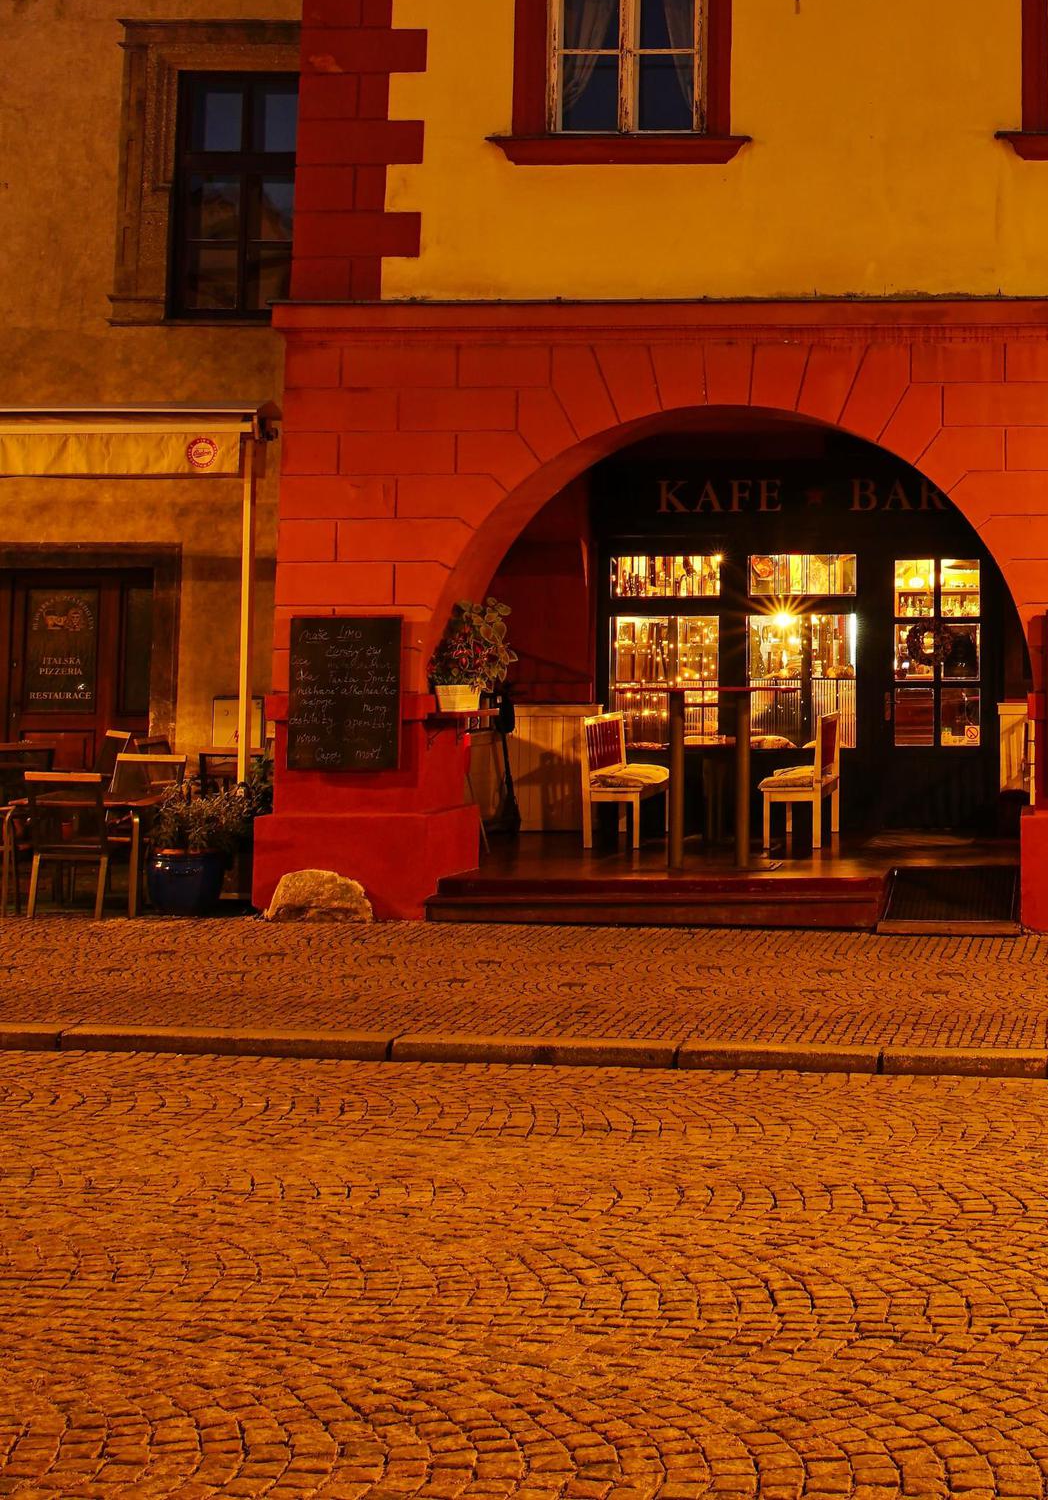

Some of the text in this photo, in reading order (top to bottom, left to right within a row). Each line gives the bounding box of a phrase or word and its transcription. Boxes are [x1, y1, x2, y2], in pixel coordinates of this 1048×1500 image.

[656, 477, 949, 512] KAFE BAR
[39, 667, 83, 675] PIZZERIA
[30, 691, 92, 700] RESTAURACE
